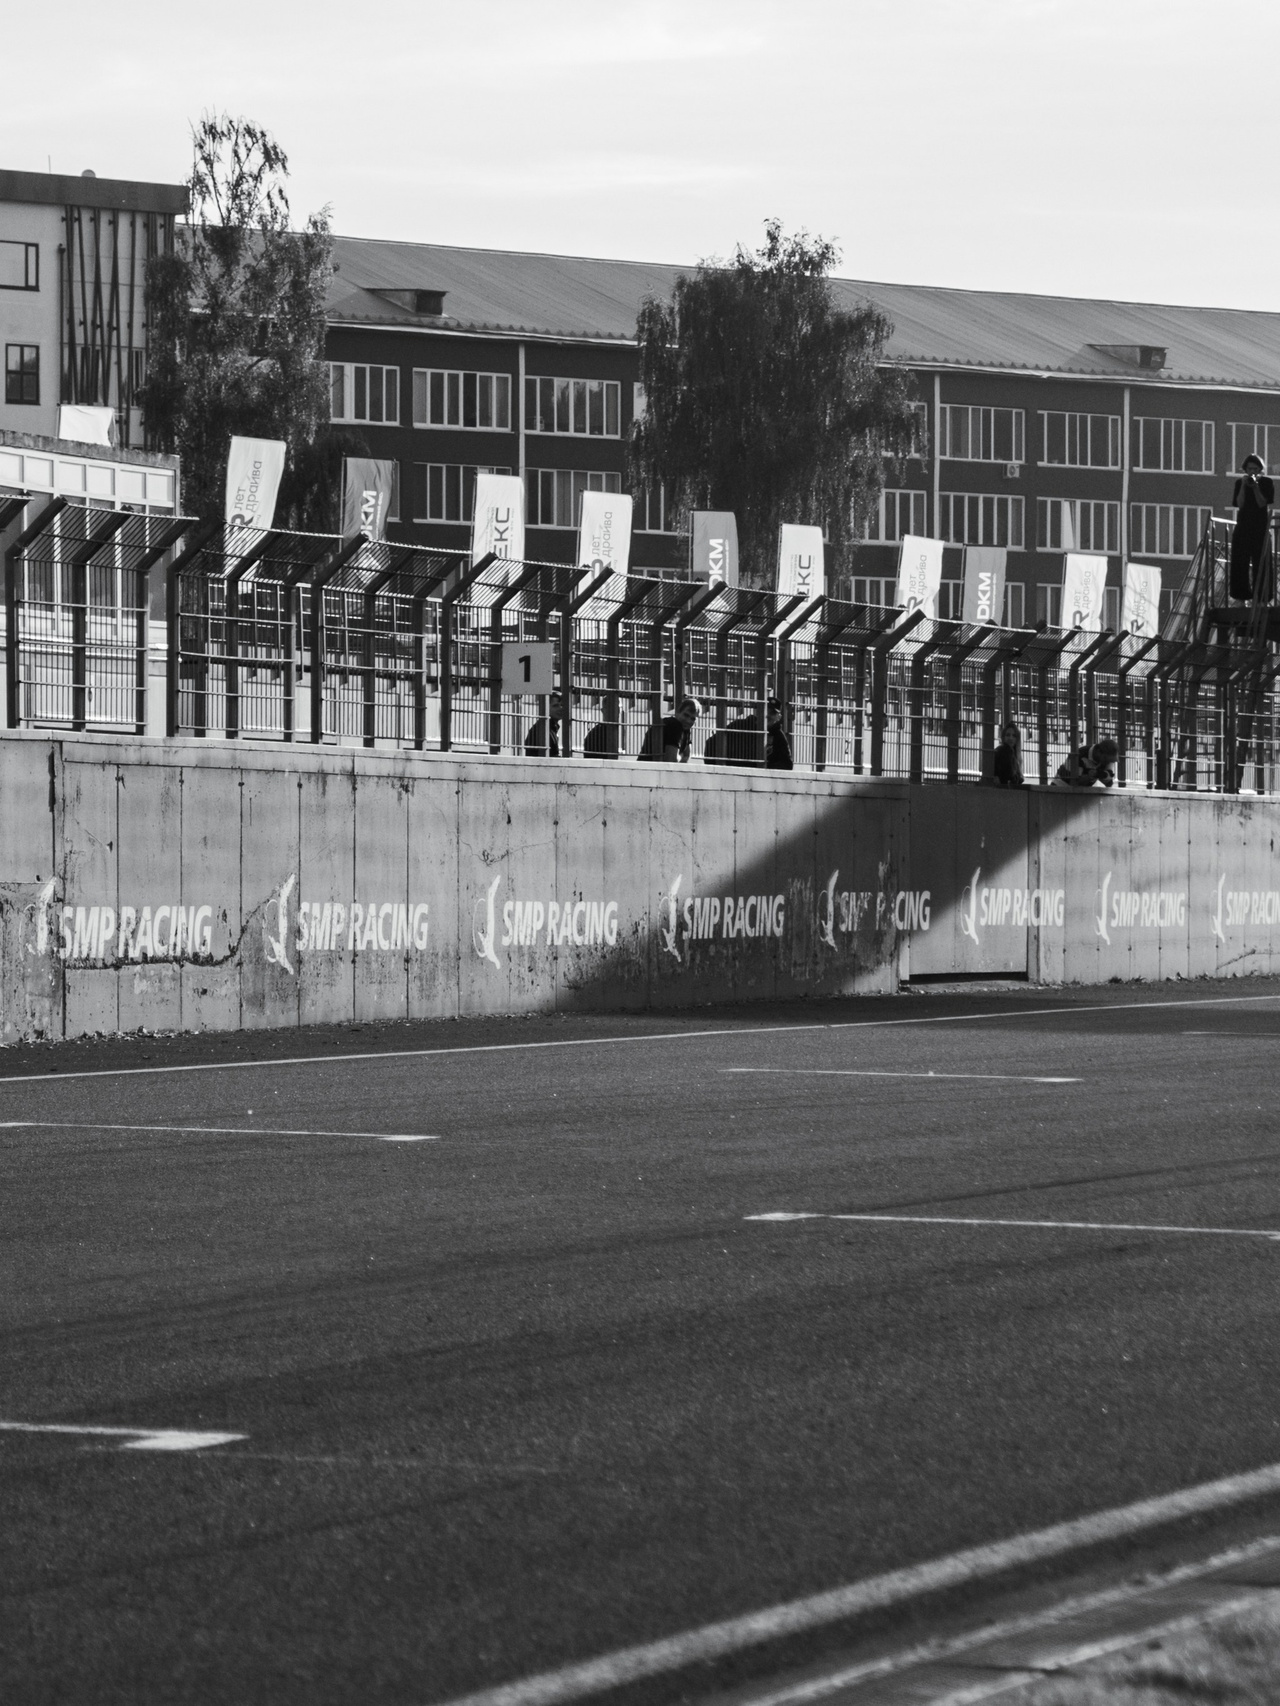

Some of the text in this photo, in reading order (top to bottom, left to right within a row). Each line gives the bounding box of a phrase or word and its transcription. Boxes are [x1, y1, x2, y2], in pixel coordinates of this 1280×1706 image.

[234, 486, 246, 511] лет
[245, 460, 263, 513] драйва
[591, 534, 600, 557] лет
[600, 511, 613, 558] драйва
[976, 572, 992, 620] DKM
[518, 655, 531, 683] 1
[296, 902, 429, 951] SMP RACING
[502, 900, 619, 947] SMP RACING
[682, 894, 785, 940] SMP RACING
[980, 888, 1065, 928] SMP RACING
[1110, 891, 1186, 927] SMP RACING
[1225, 891, 1250, 926] SMP
[56, 904, 213, 960] SMP RACING
